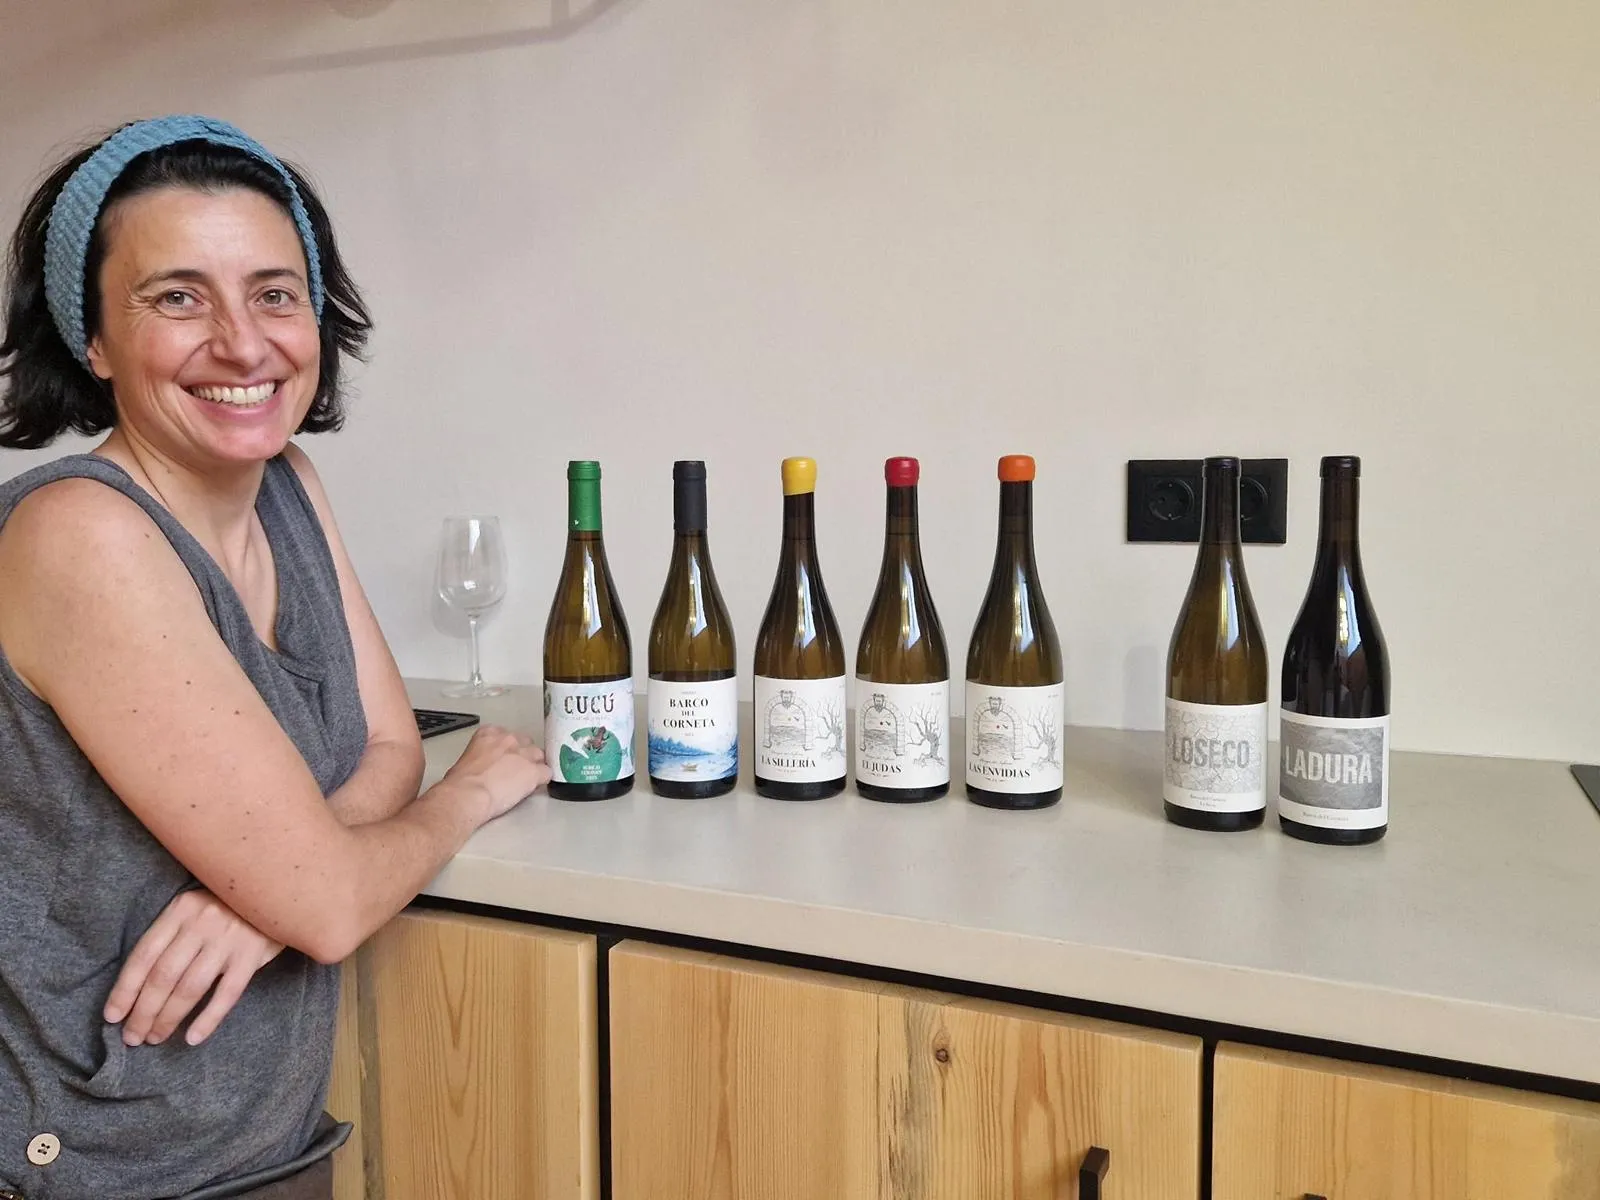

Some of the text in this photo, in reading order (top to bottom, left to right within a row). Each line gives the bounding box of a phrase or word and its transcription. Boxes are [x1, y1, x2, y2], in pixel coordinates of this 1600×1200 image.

[564, 693, 615, 714] CUCÚ
[669, 698, 709, 708] BARCO
[663, 719, 716, 728] CORNETA
[1172, 734, 1250, 769] LOSECO
[761, 755, 771, 765] LA
[862, 759, 902, 773] EL JUDAS
[1285, 745, 1373, 784] LADURA
[968, 761, 981, 774] LAS
[982, 766, 1031, 778] ENVIDIAS
